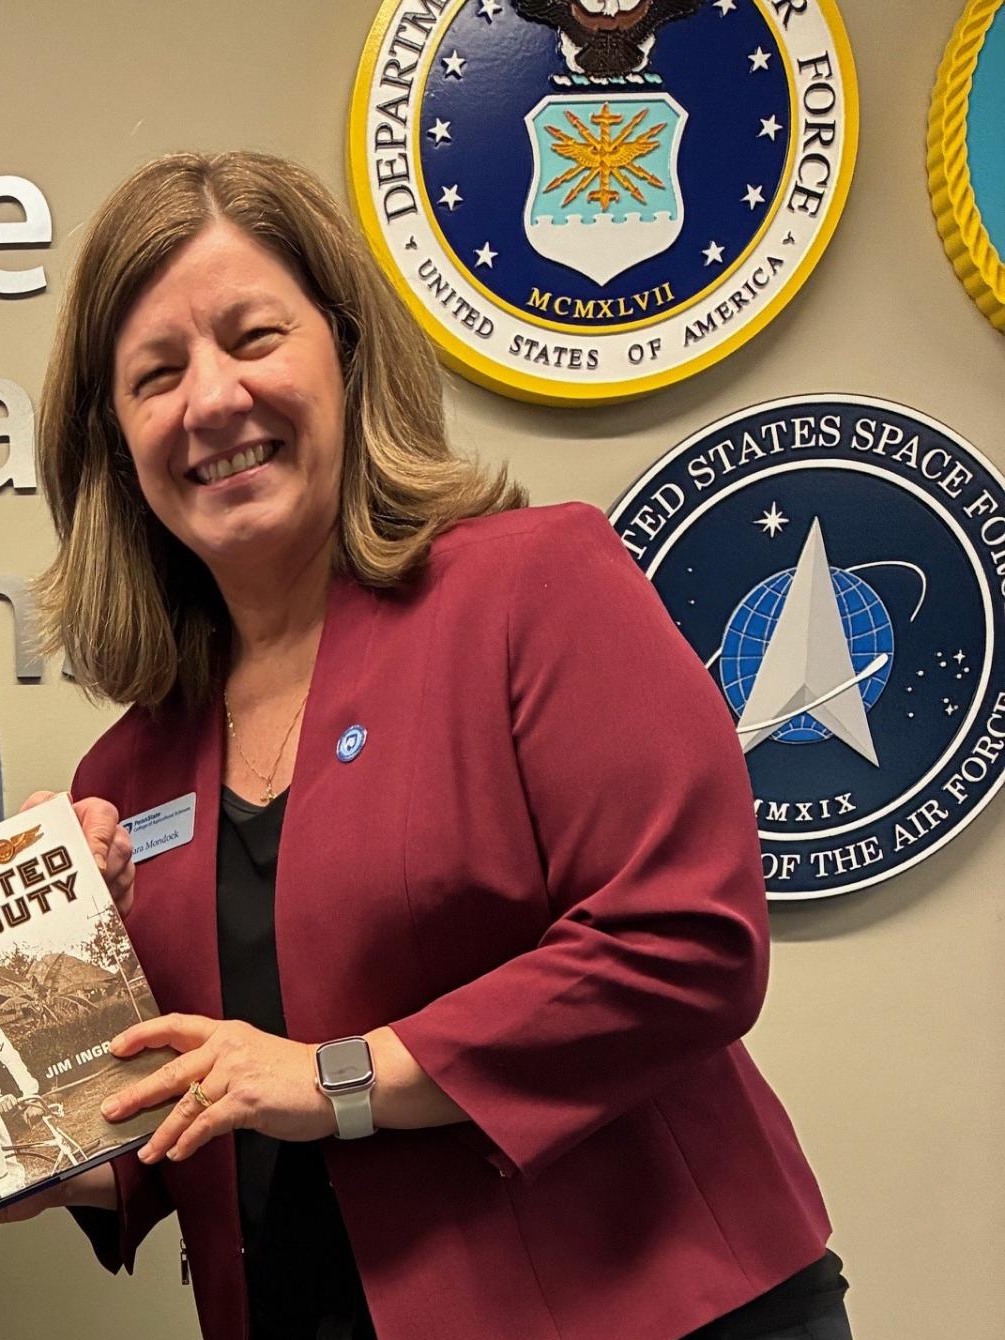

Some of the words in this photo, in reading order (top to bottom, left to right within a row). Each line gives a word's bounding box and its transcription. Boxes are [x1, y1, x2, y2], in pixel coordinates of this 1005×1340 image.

[796, 50, 836, 219] FORCE
[417, 258, 495, 339] UNITED
[509, 335, 599, 369] STATES
[628, 339, 662, 364] OF
[683, 254, 785, 347] AMERICA
[526, 283, 675, 319] MCMXLVII
[687, 415, 841, 491] STATES
[851, 418, 973, 498] SPACE
[761, 853, 800, 880] OF
[810, 836, 883, 878] THE
[893, 800, 949, 851] AIR
[46, 1059, 72, 1078] JIM
